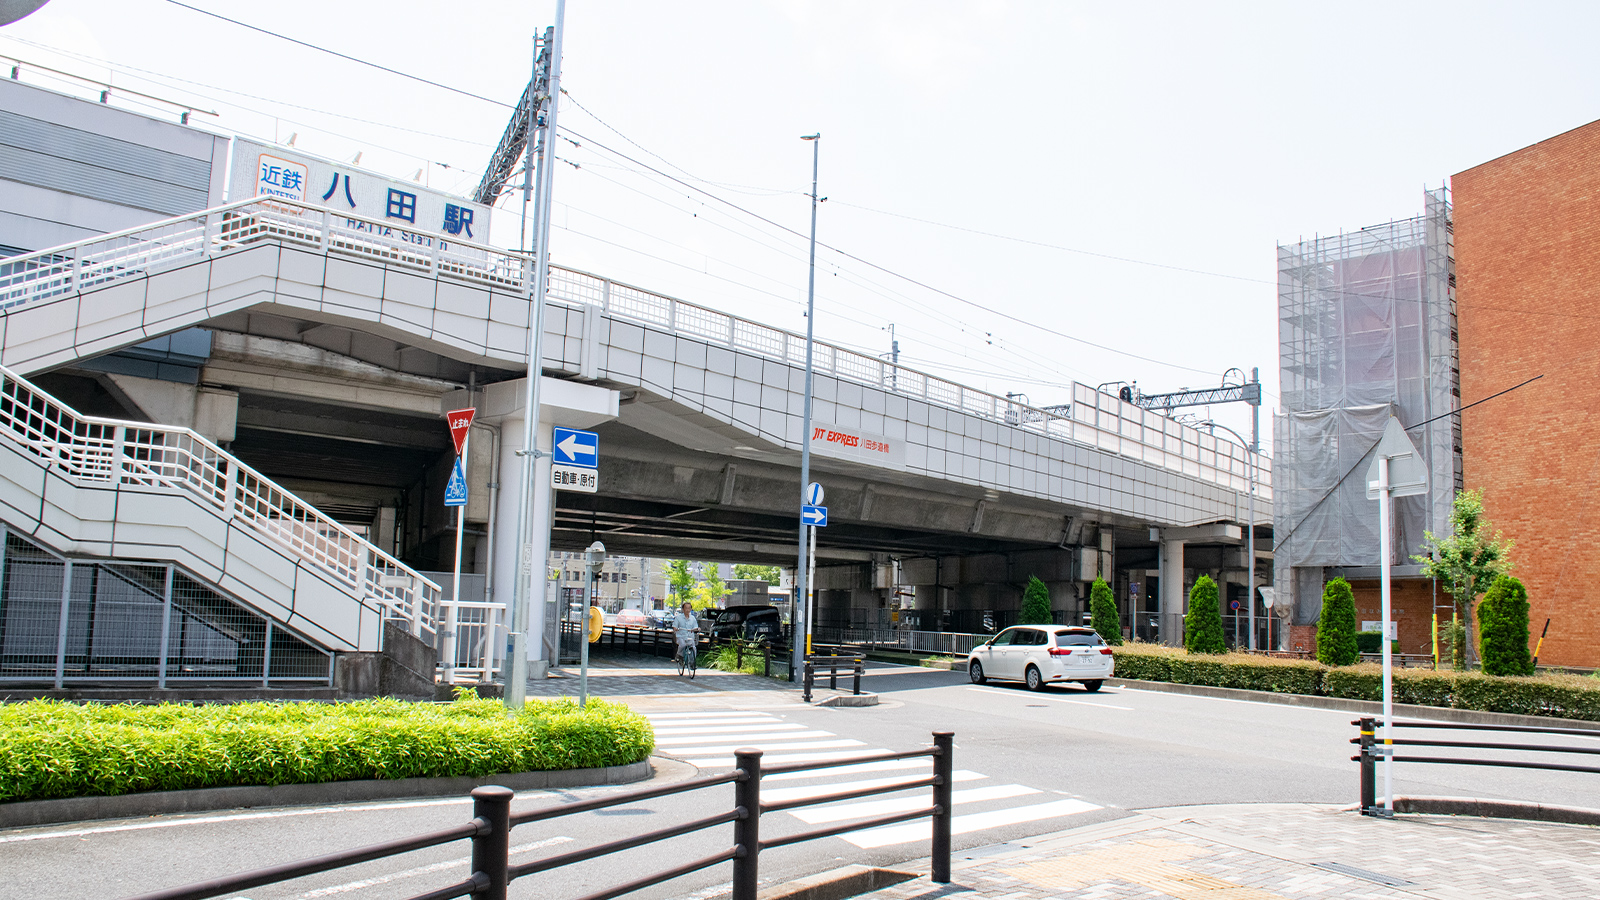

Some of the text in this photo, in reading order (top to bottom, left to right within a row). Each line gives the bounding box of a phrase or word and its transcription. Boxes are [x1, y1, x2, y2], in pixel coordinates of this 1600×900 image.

[261, 163, 302, 192] 近鉄
[322, 172, 474, 239] 八田駅
[402, 231, 448, 251] Stain
[452, 418, 469, 429] 止まれ
[812, 427, 826, 440] JIT
[826, 430, 859, 447] EXPRESS
